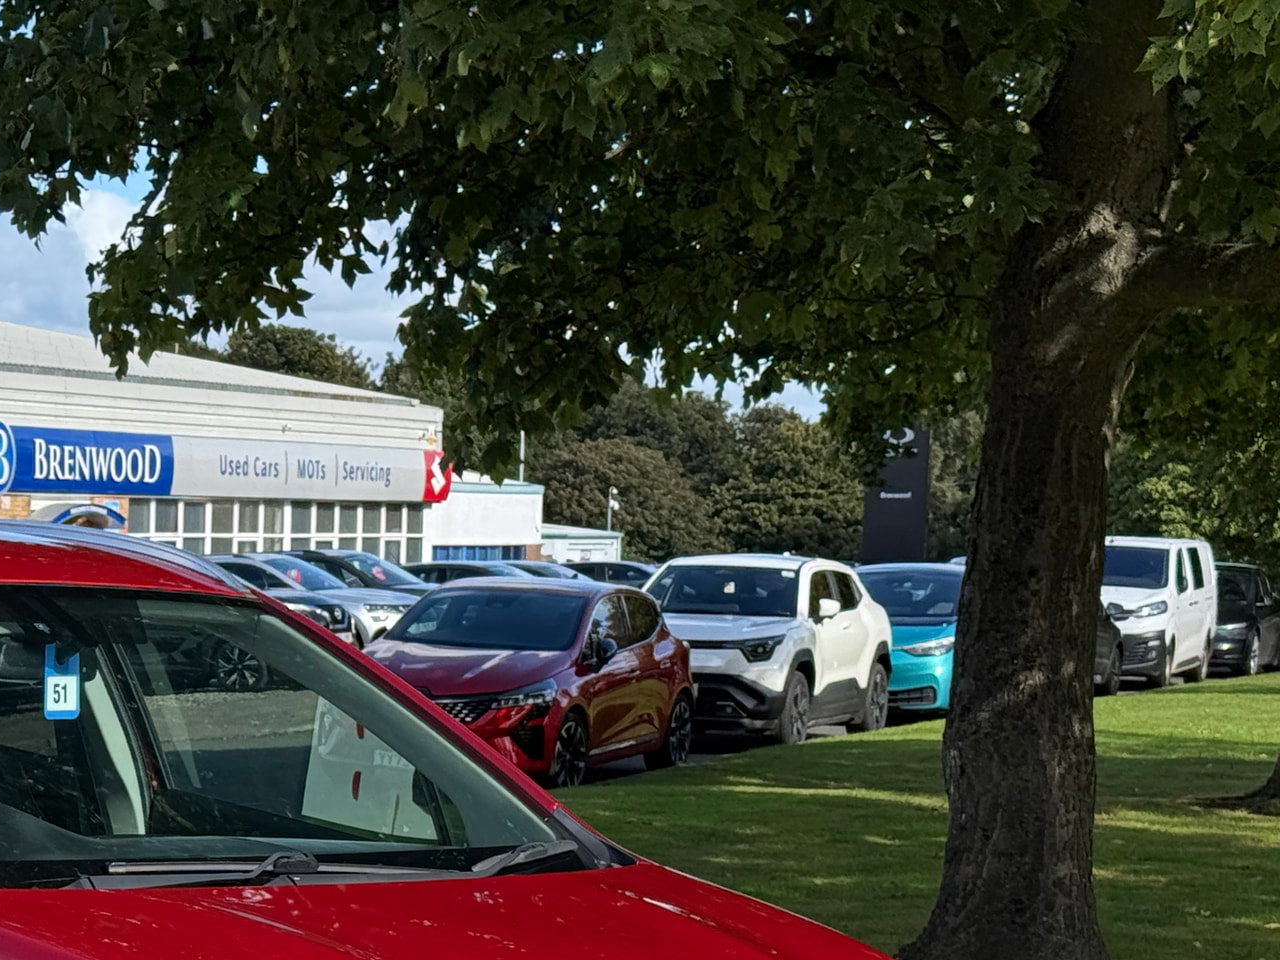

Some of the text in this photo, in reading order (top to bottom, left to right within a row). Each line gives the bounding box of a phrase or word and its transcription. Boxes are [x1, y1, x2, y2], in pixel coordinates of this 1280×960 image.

[33, 438, 162, 484] BRENWOOD
[219, 454, 280, 478] Used Cars
[297, 458, 326, 480] MOTs
[342, 461, 391, 488] Servicing
[53, 683, 67, 704] 51
